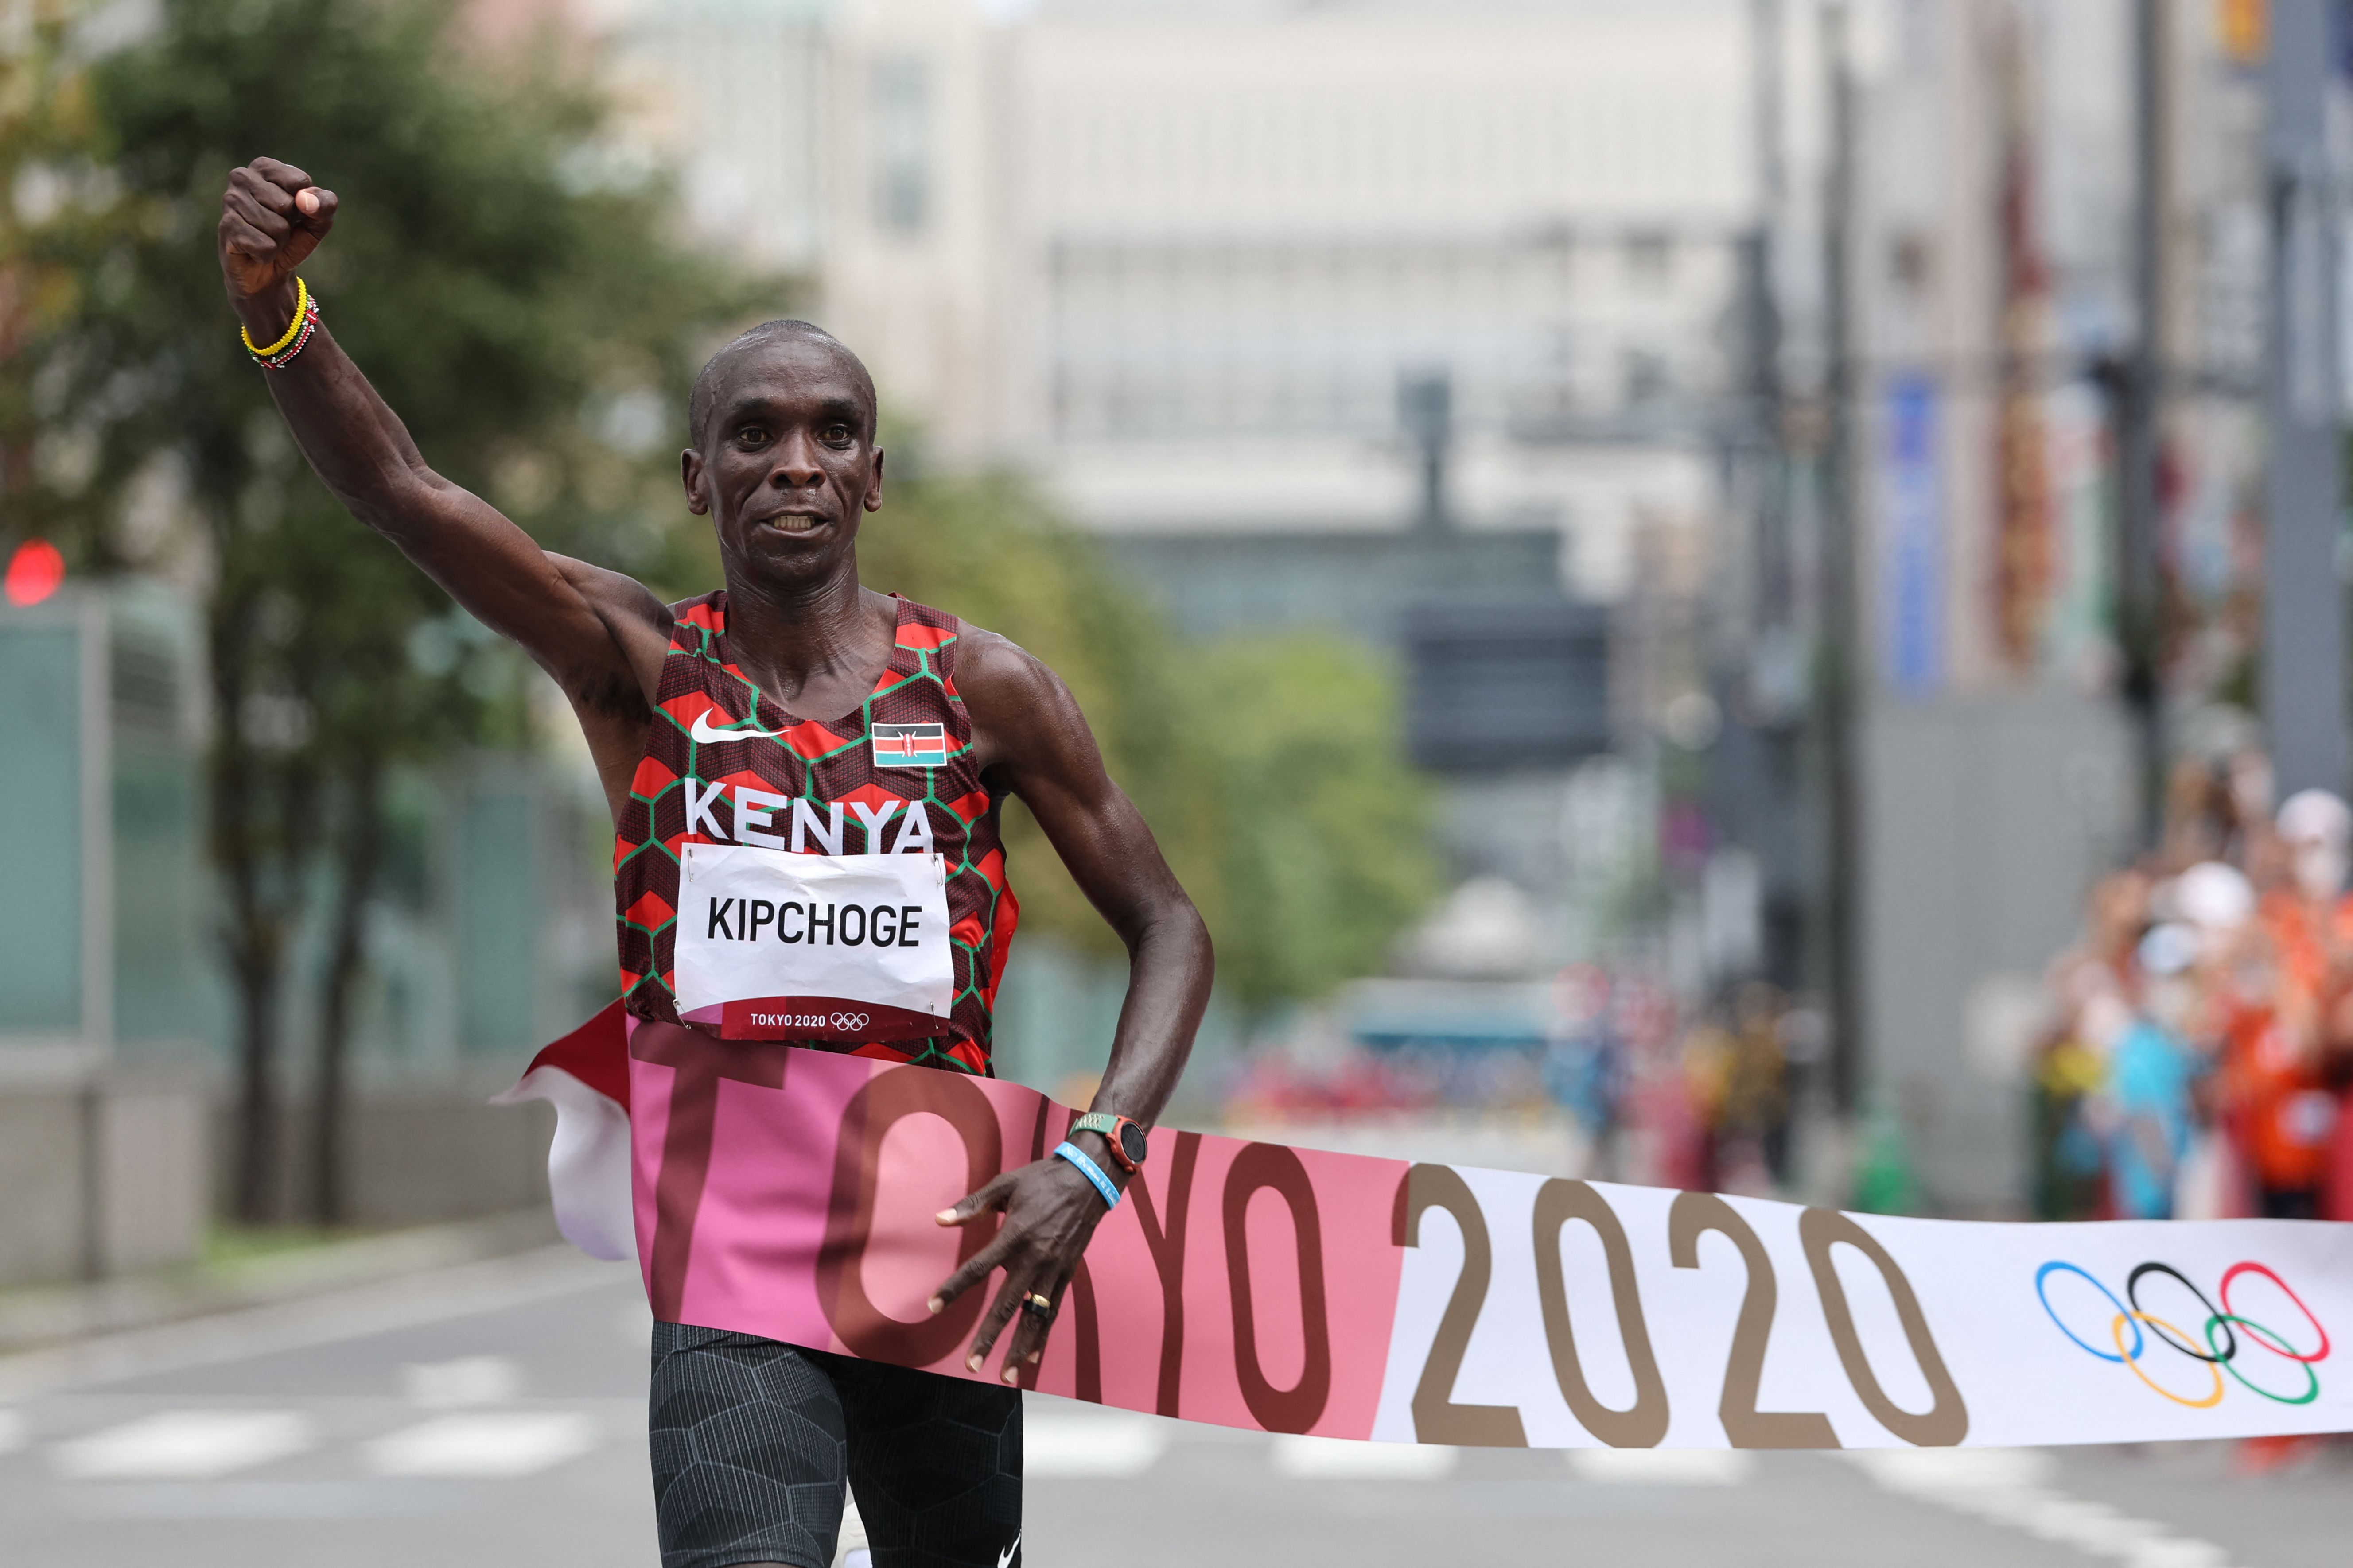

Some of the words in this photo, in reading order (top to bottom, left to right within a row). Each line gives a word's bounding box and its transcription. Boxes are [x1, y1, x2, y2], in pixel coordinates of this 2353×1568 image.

[685, 777, 934, 855] KENYA
[708, 897, 922, 947] KIPCHOGE
[750, 1013, 792, 1027] TOKYO
[794, 1015, 826, 1027] 2020
[1391, 1162, 1969, 1449] 2020
